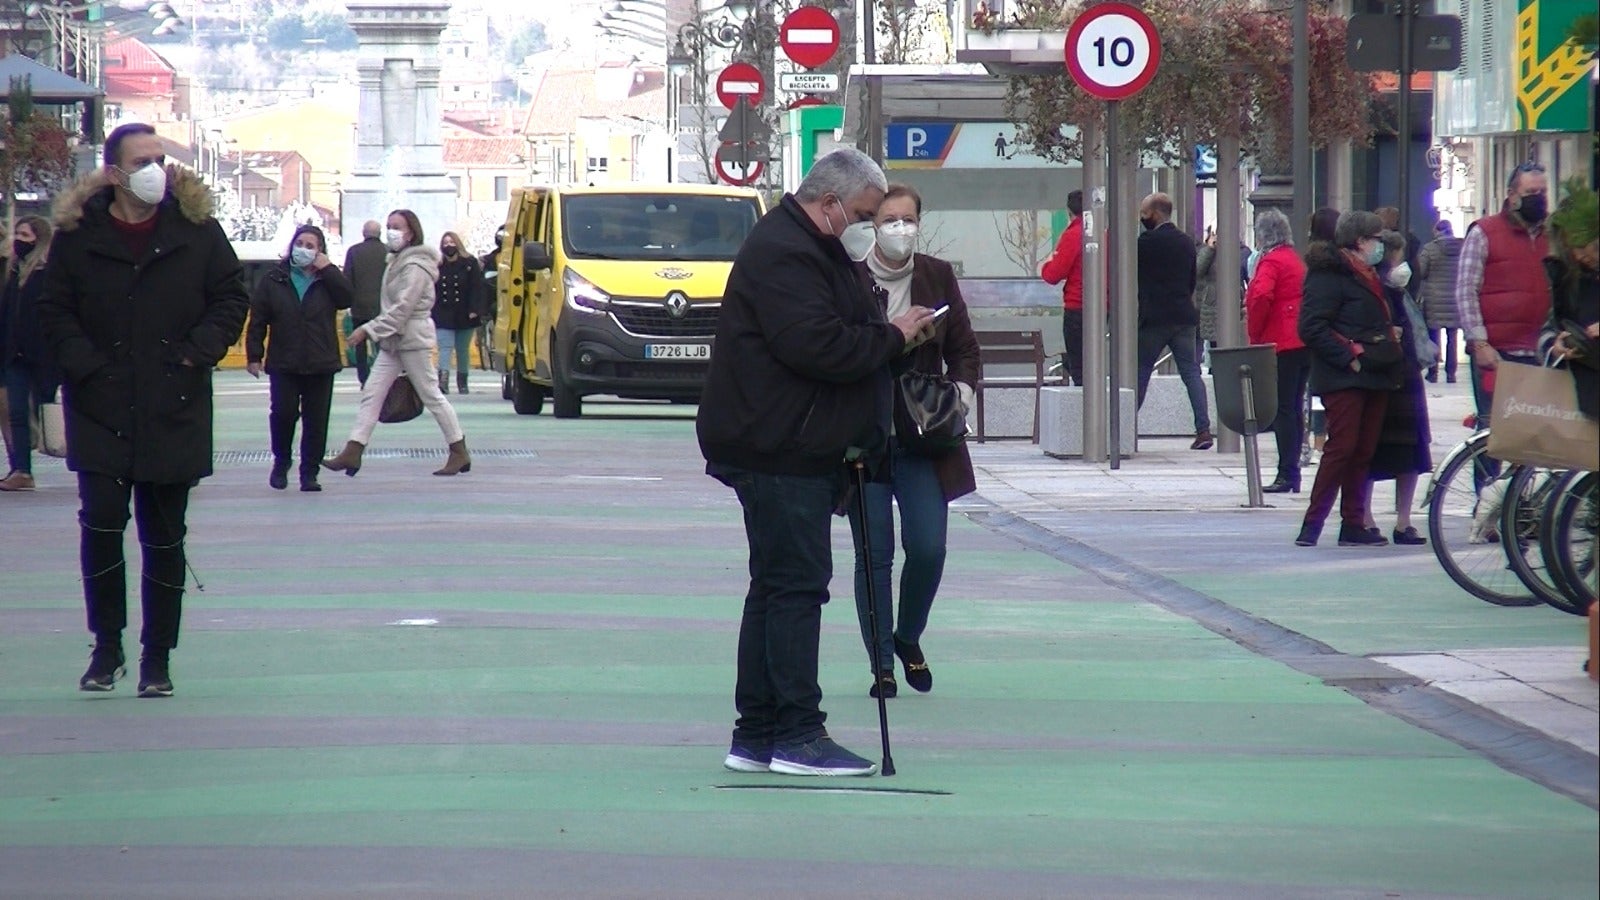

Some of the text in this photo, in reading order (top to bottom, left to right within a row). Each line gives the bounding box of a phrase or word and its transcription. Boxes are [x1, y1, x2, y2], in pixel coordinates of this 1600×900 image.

[1093, 36, 1135, 67] 10
[906, 127, 927, 157] P
[653, 346, 707, 357] 3726 LJB
